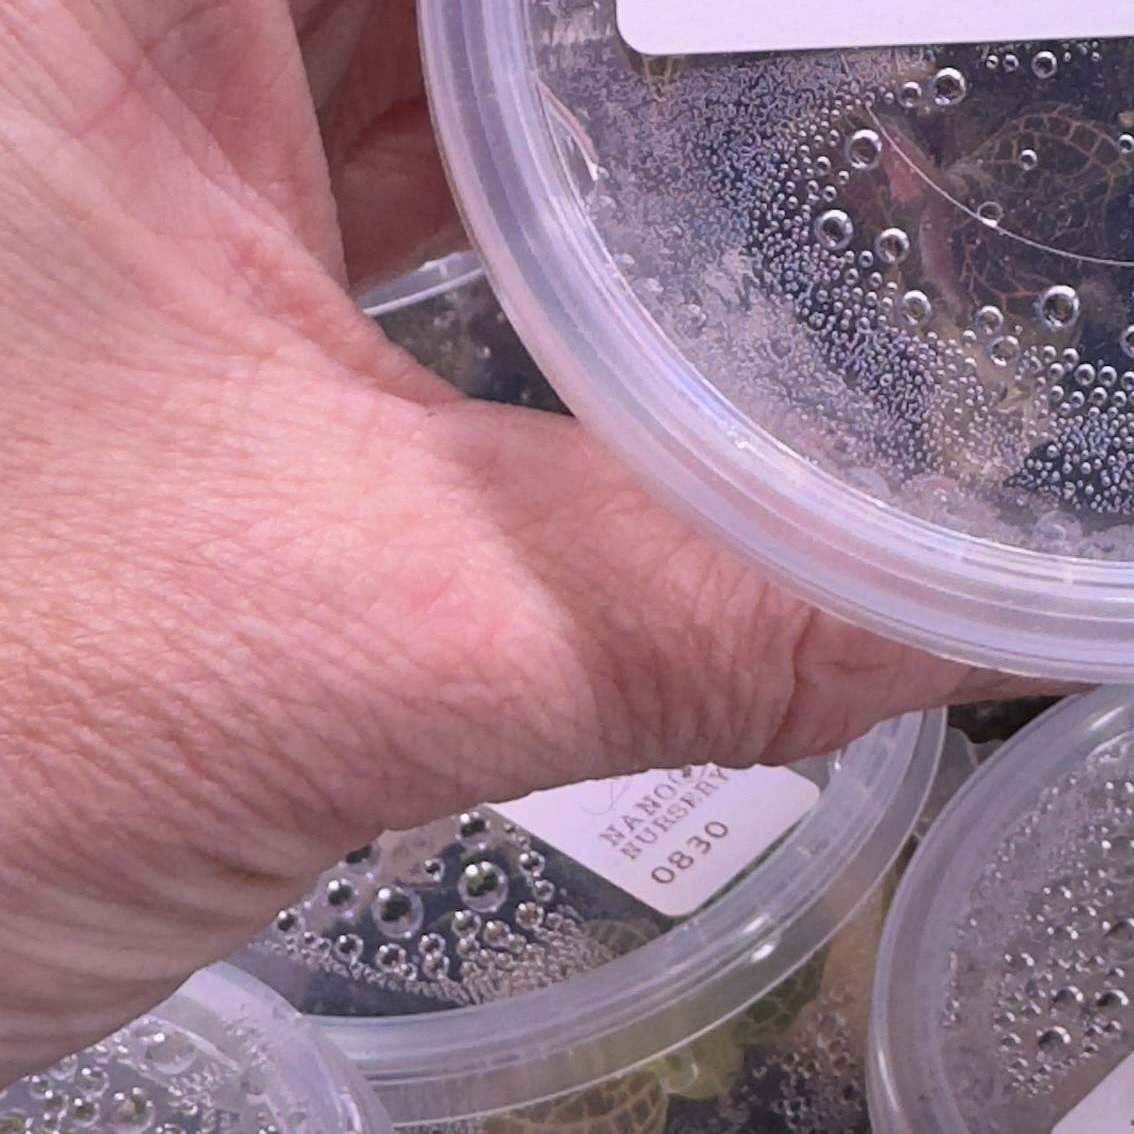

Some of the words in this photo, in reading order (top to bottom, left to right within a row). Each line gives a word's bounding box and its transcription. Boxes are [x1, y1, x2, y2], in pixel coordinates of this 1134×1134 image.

[598, 783, 678, 848] NANO
[620, 767, 729, 859] NURSERY
[650, 820, 730, 885] 0830
